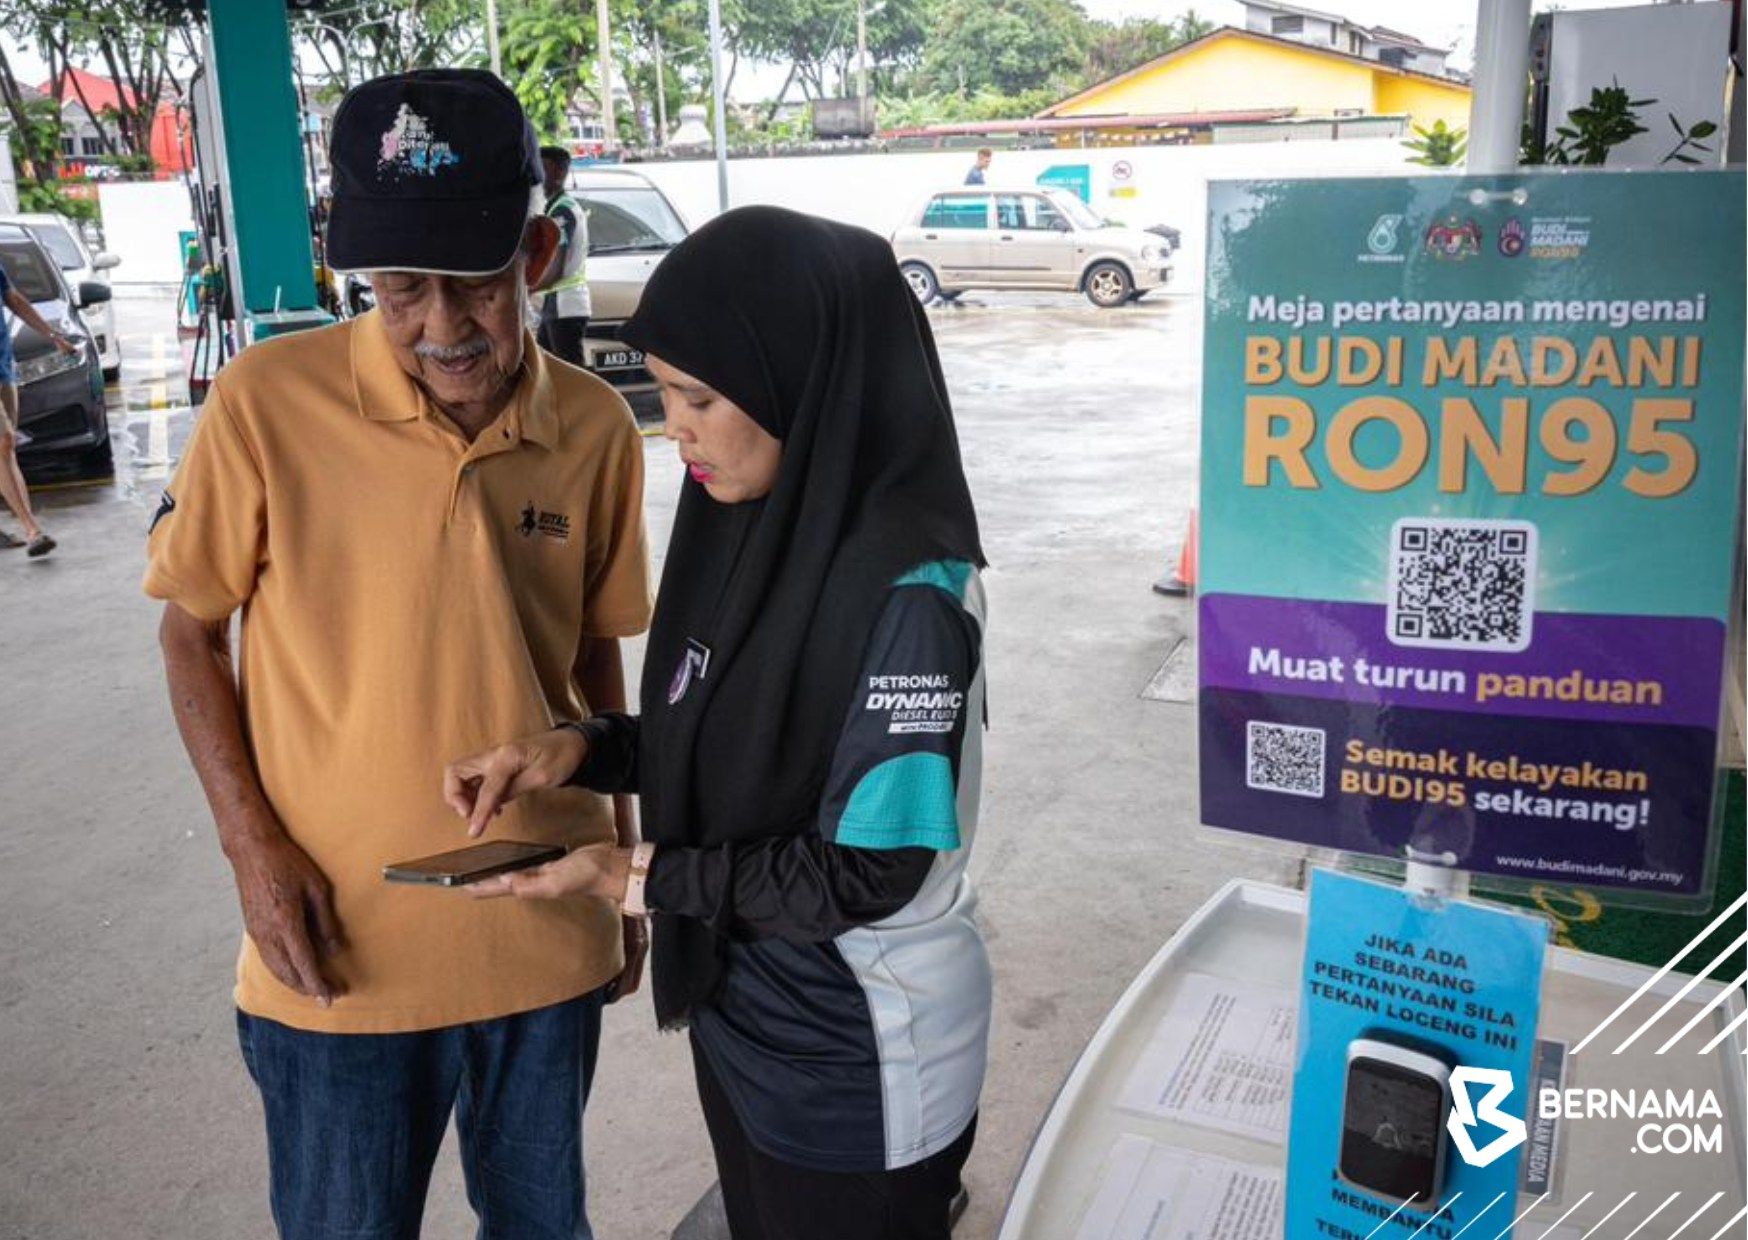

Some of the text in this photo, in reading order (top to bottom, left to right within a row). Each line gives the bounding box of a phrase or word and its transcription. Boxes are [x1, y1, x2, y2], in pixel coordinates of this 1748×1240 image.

[1248, 294, 1707, 330] Meja pertanyaan mengenai
[1245, 336, 1700, 388] BUDI MADANI
[1242, 396, 1699, 497] RON95
[869, 674, 950, 690] PETRONAS
[1248, 647, 1663, 706] Muat turun panduan
[1344, 739, 1649, 792] Semak kelayakan
[1340, 768, 1651, 832] BUDI95 sekarang!
[1496, 854, 1684, 886] www.budimadani.gov.my
[1354, 951, 1476, 995] SEBARANG
[1364, 933, 1468, 971] JIKA ADA
[1309, 980, 1518, 1051] TEKAN LOCENG INI
[1314, 960, 1516, 1028] PERTANYAAN SILA
[1331, 1188, 1452, 1240] MEMBANTU
